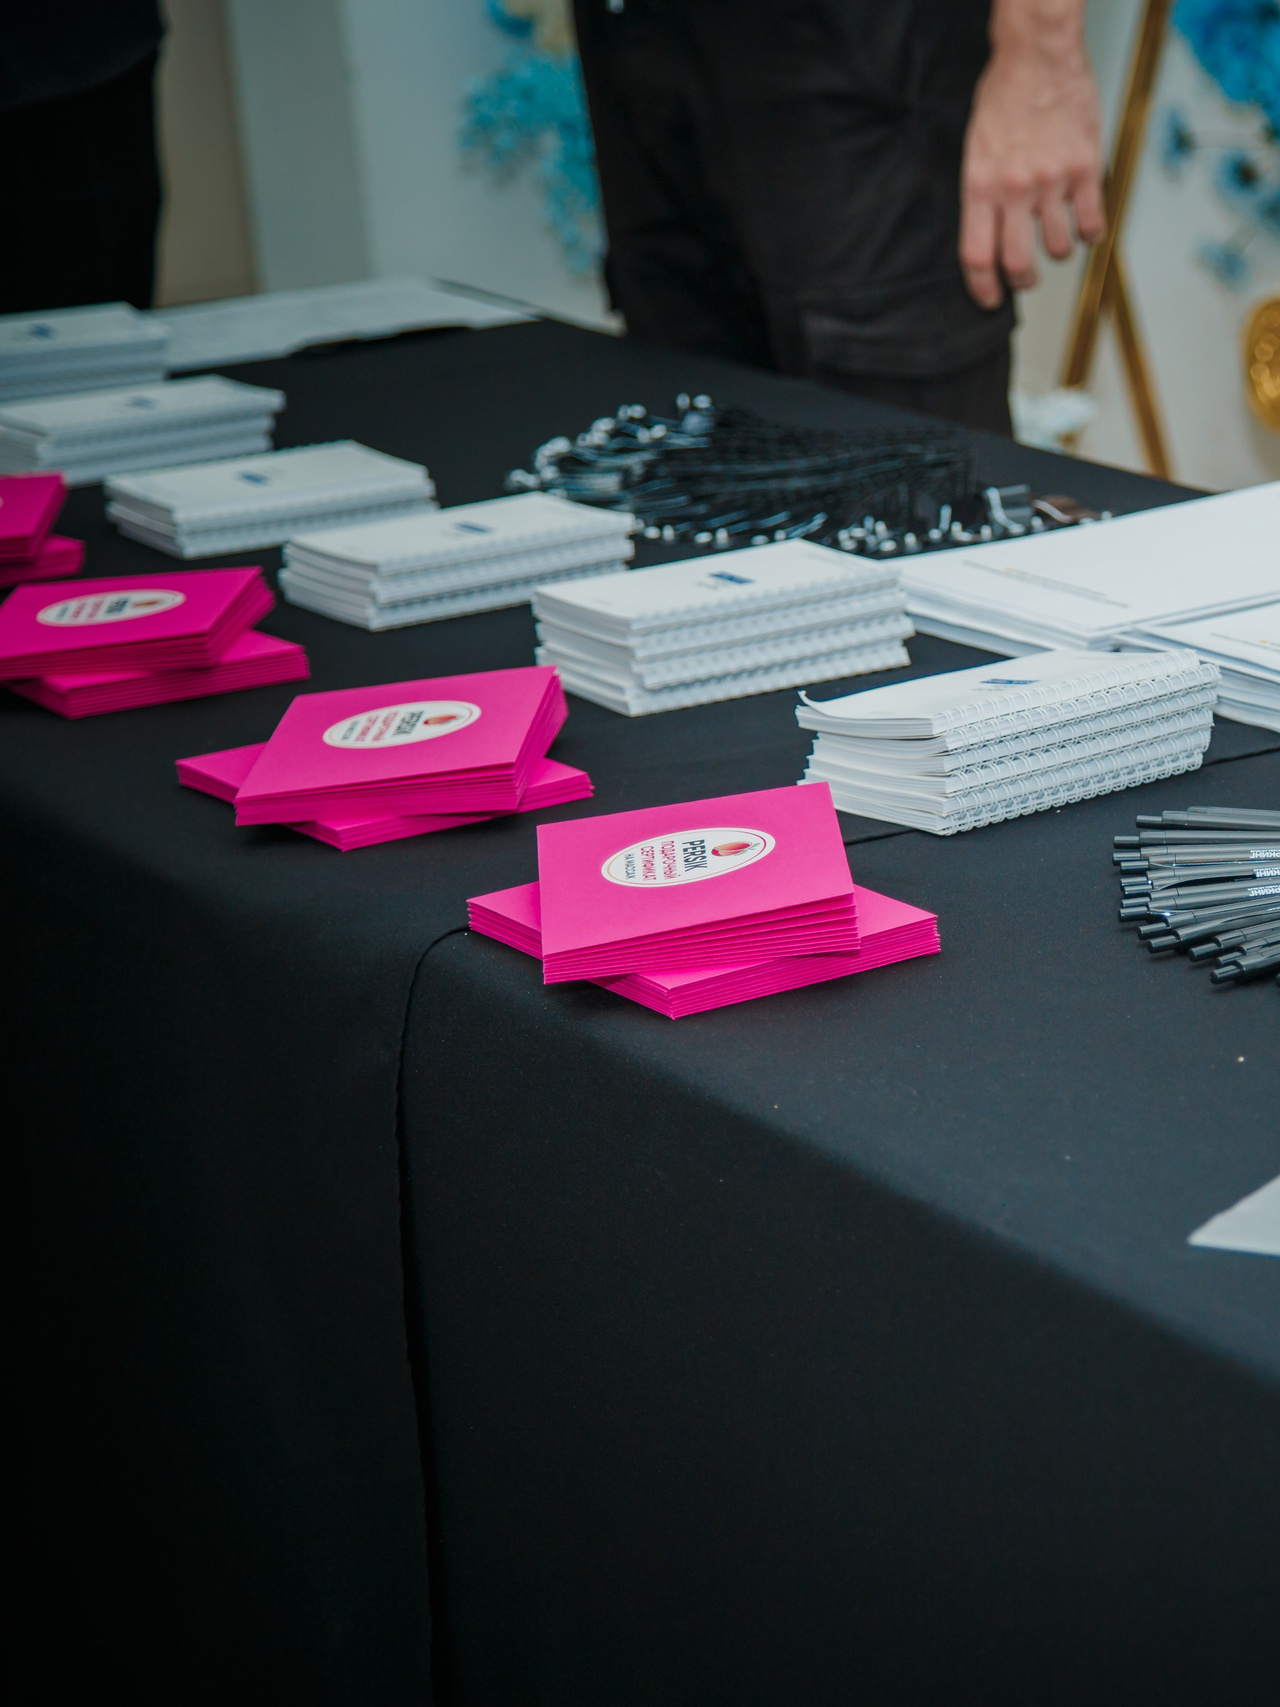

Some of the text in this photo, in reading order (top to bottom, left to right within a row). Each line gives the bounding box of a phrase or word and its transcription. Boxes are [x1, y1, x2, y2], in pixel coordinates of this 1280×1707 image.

[640, 845, 657, 881] СЕРТИФИКАТ
[659, 840, 682, 880] ПОДАРОЧНЫЙ
[682, 839, 708, 872] PERSIK
